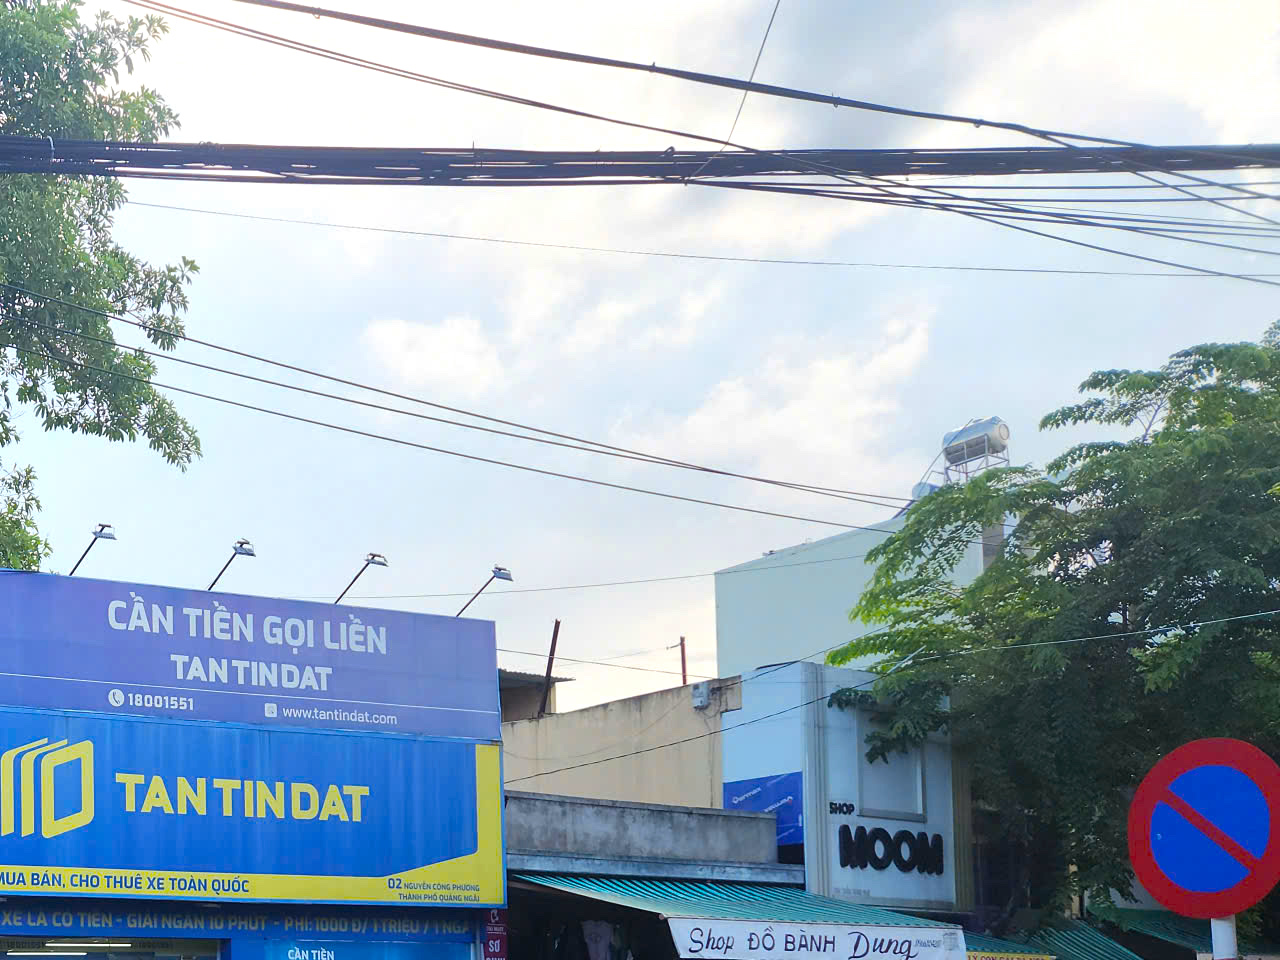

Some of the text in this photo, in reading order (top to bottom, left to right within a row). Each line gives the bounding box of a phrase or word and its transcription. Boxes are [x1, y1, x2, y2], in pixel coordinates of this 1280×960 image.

[108, 591, 388, 655] CẦN TIỀN GỌI LIỀN
[127, 692, 195, 711] 18001551
[282, 707, 398, 726] www.tantindat.com
[829, 801, 855, 815] SHOP
[30, 869, 67, 889] BÁN,
[69, 874, 101, 889] CHO
[104, 873, 144, 890] THUÊ
[146, 876, 166, 891] XE
[168, 874, 209, 892] TOÀN
[211, 876, 250, 895] QUỐC
[387, 878, 403, 890] 02
[688, 926, 735, 955] Shop
[747, 926, 776, 951] ĐỒ
[784, 929, 836, 953] BÀNH
[287, 946, 335, 960] CẦN TIỀN
